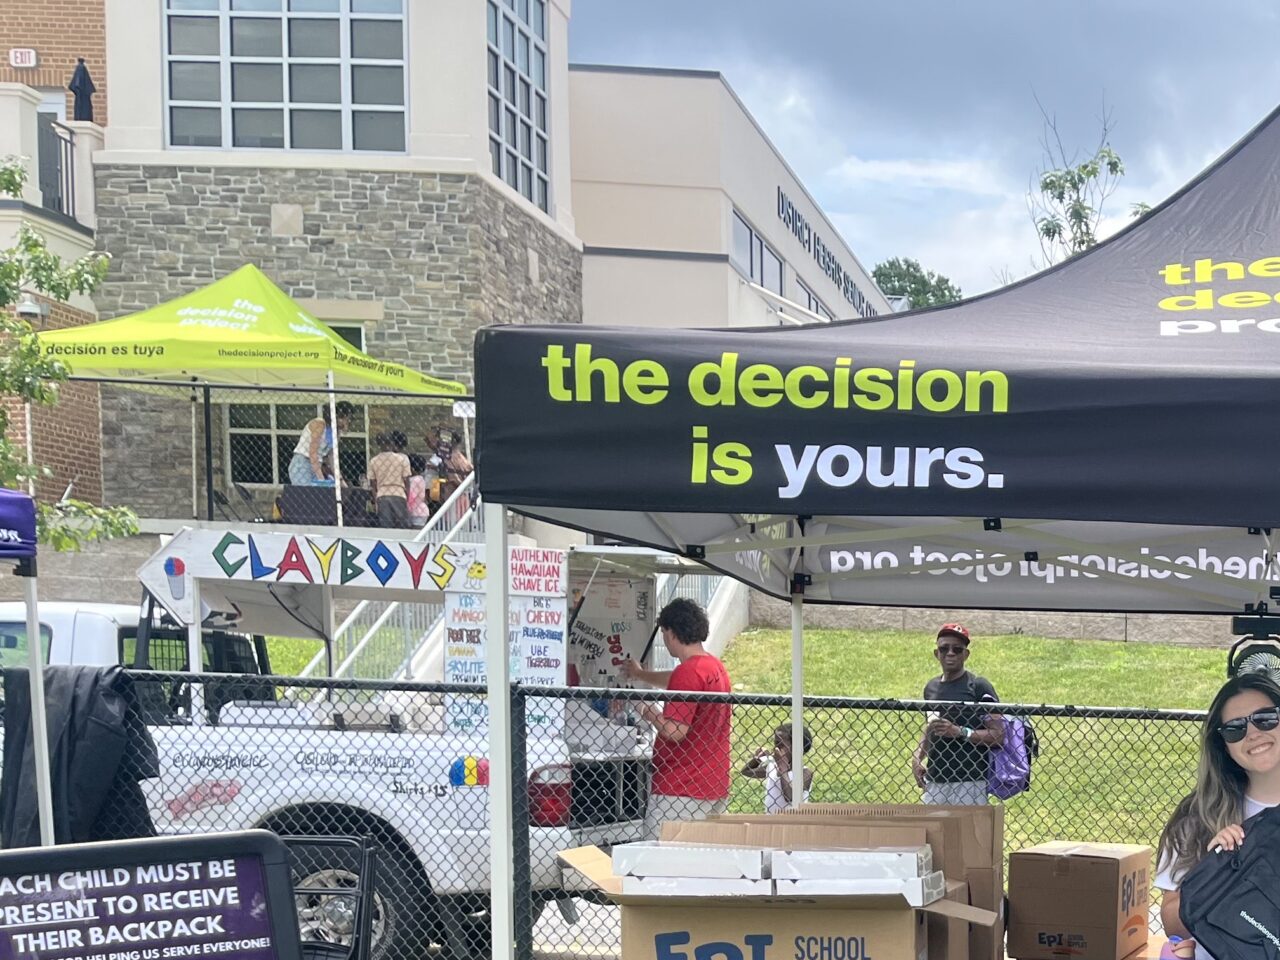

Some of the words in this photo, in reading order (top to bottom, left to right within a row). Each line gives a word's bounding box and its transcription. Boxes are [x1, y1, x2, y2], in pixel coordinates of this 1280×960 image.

[14, 50, 32, 65] EXIT
[777, 185, 811, 253] DISTRICT
[813, 231, 842, 290] HEIGHTS
[233, 298, 265, 313] the
[176, 306, 258, 323] decision
[46, 342, 107, 356] decisión
[111, 346, 128, 356] es
[133, 344, 165, 358] tuya
[217, 348, 320, 360] thedecisionproject.org
[541, 343, 669, 406] the
[687, 351, 1009, 414] decision
[690, 425, 754, 486] is
[774, 443, 1005, 499] yours.
[211, 531, 458, 591] CLAYBOYS
[510, 549, 564, 564] AUTHENTIC
[510, 562, 560, 578] HAWAIIAN
[511, 577, 542, 592] SHAVE
[544, 578, 560, 593] ICE
[526, 609, 562, 625] CHERRY
[530, 644, 550, 657] UBE
[0, 873, 53, 896] ACH
[57, 867, 130, 890] CHILD
[136, 861, 203, 885] MUST
[208, 858, 237, 878] BE
[102, 895, 138, 916] TO
[143, 886, 240, 912] RECEIVE
[12, 928, 85, 953] THEIR
[88, 914, 226, 946] BACKPACK
[142, 948, 160, 960] US
[162, 944, 201, 959] SERVE
[203, 937, 271, 955] EVERYONE!
